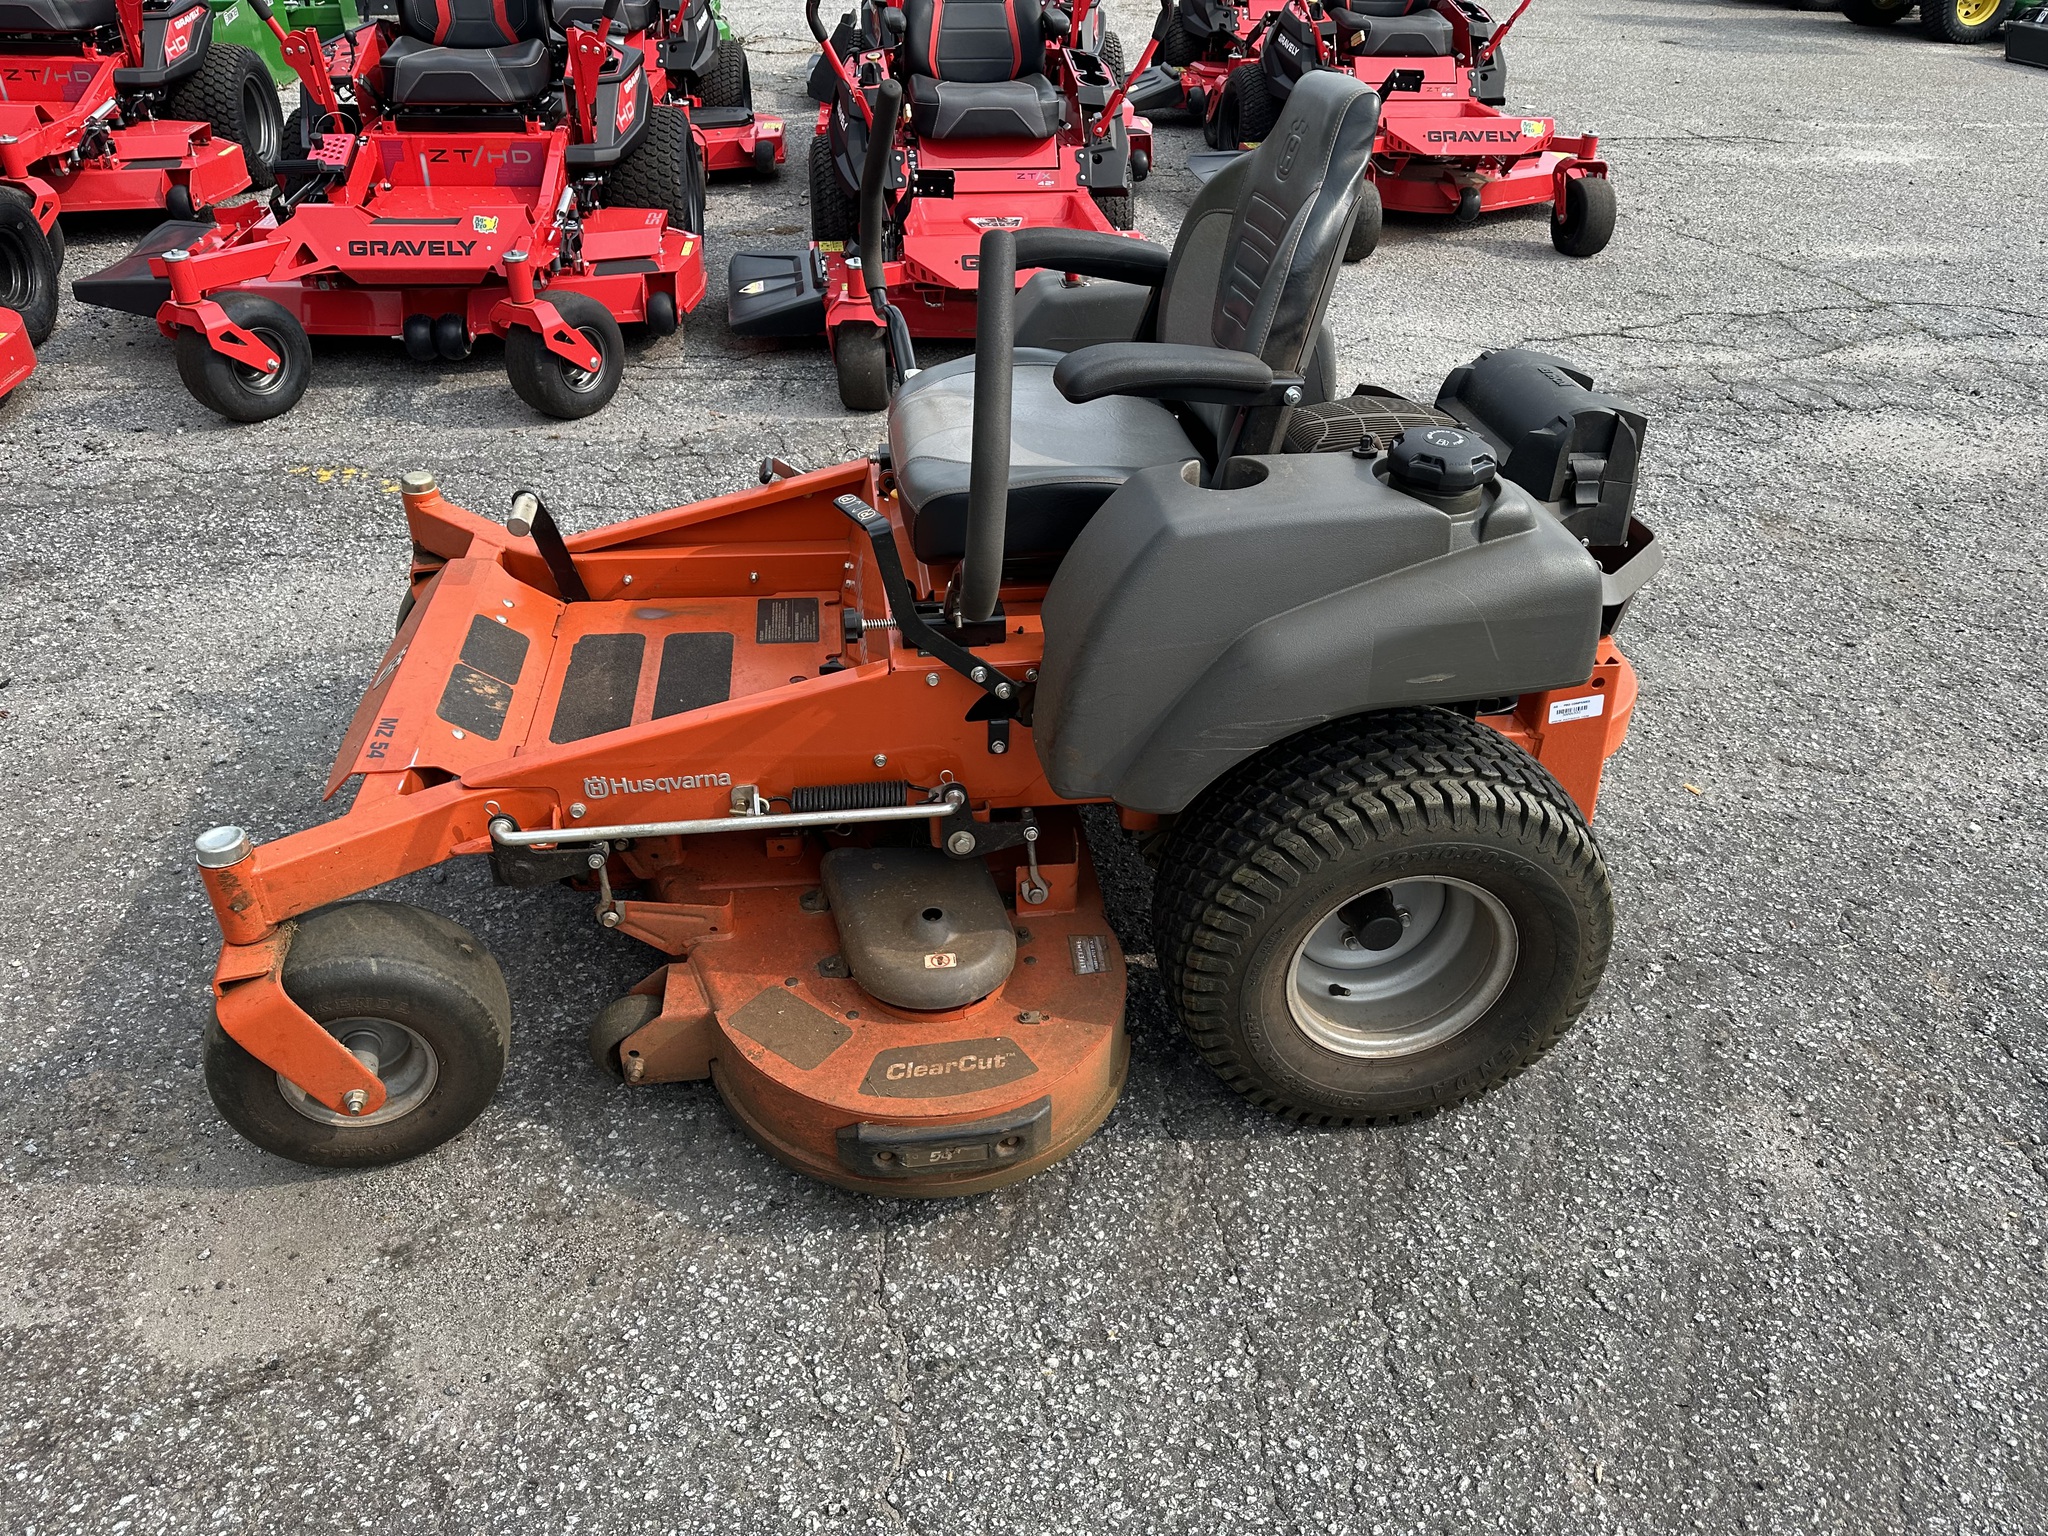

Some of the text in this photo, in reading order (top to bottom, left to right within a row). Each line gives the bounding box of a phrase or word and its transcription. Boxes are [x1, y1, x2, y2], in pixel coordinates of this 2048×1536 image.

[173, 8, 200, 30] GRAVELY
[165, 35, 188, 57] HD
[1277, 32, 1300, 56] GRAVELY
[617, 100, 635, 128] HD
[1428, 131, 1521, 143] GRAVELY
[348, 240, 477, 256] GRAVELY
[366, 717, 399, 759] MZ 54
[609, 771, 732, 795] Husqvarna
[313, 998, 410, 1015] KENDA
[1432, 1015, 1540, 1100] KENDA
